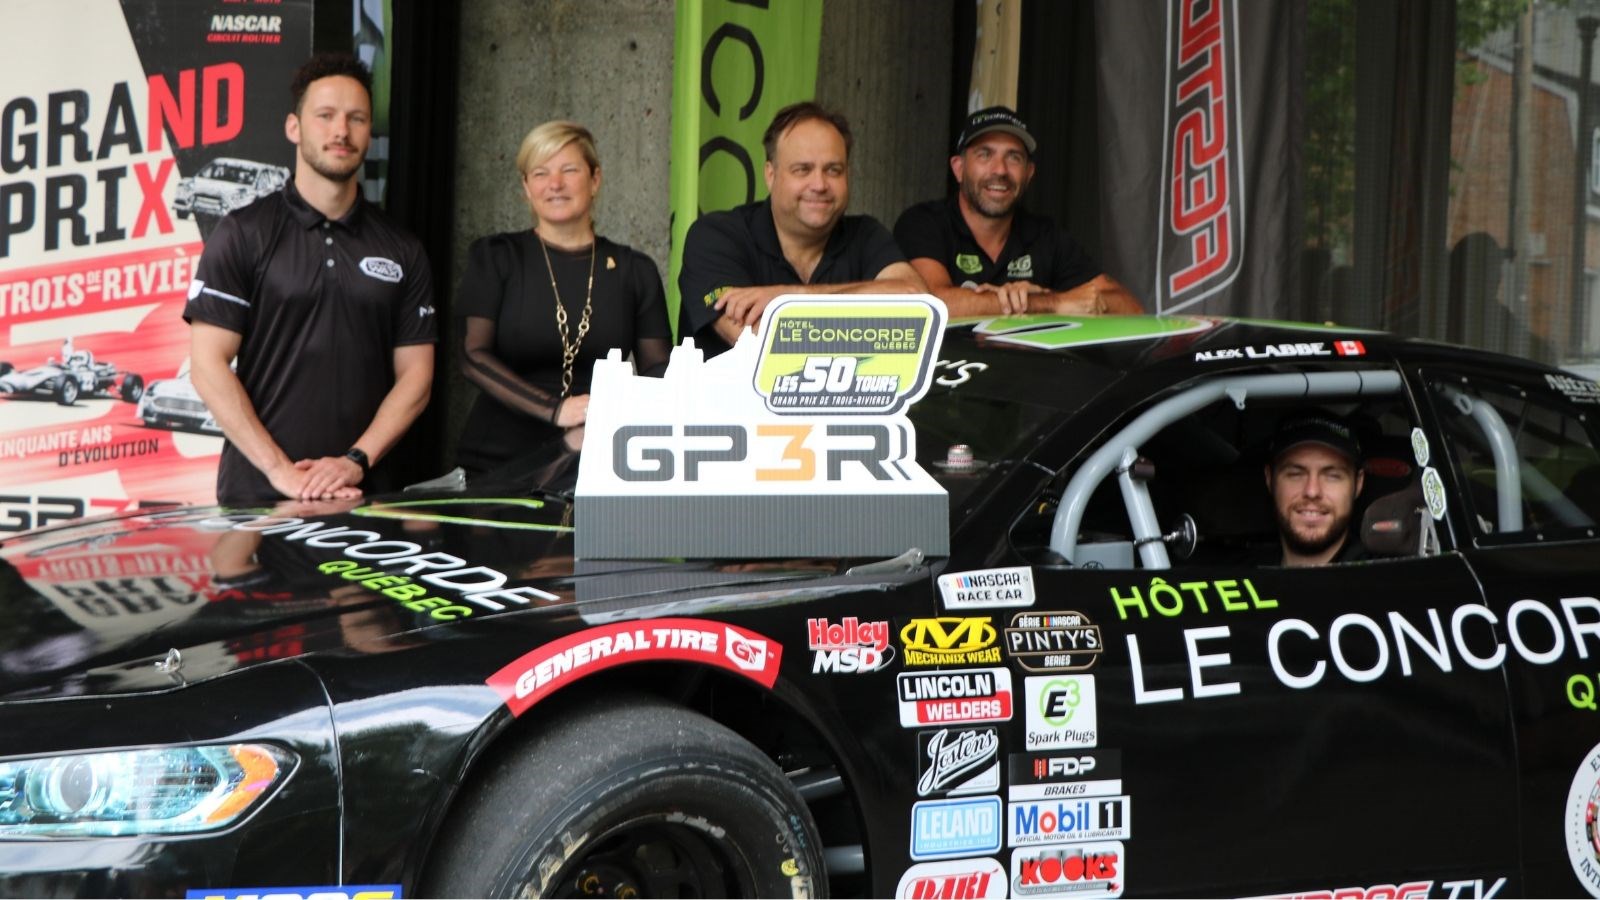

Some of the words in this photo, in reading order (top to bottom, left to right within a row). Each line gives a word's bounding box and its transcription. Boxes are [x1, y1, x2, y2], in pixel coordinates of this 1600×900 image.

[211, 15, 282, 32] NASCAR
[1, 62, 245, 175] GRAND
[0, 157, 176, 258] PRIX
[0, 271, 85, 318] TROIS
[87, 269, 102, 290] DE
[779, 319, 815, 329] HÔTEL
[779, 329, 803, 342] LE
[808, 328, 916, 342] CONCORDE
[1196, 349, 1243, 361] ALEX
[773, 376, 800, 393] LES
[798, 356, 858, 393] 50
[854, 375, 900, 393] TOURS
[772, 395, 798, 406] GRAND
[800, 395, 817, 406] PRIX
[819, 395, 830, 406] DE
[80, 425, 113, 446] ANS
[59, 437, 159, 468] D'ÉVOLUTION
[611, 424, 902, 482] GP3R
[968, 572, 1021, 588] NASCAR
[957, 590, 992, 601] RACE
[996, 588, 1023, 600] CAR
[1110, 577, 1279, 620] HÔTEL
[1018, 615, 1040, 627] SÉRIE
[1052, 615, 1081, 626] NASCAR
[808, 616, 889, 652] Holley
[1011, 629, 1098, 651] PINTY'S
[514, 629, 651, 700] GENERAL
[652, 627, 719, 654] TIRE
[812, 649, 884, 674] MSD
[904, 650, 966, 666] MECHANIX
[967, 649, 1002, 664] WEAR
[1044, 655, 1071, 667] SERIES
[1126, 625, 1241, 705] LE
[903, 674, 992, 700] LINCOLN
[925, 699, 1001, 720] WELDERS
[1028, 730, 1060, 745] Spark
[1064, 729, 1095, 744] Plugs
[918, 728, 999, 796] Jostens
[1048, 756, 1096, 776] FDP
[1043, 784, 1087, 796] BRAKES
[920, 807, 993, 839] LELAND
[1015, 801, 1090, 835] Mobil
[1020, 852, 1118, 885] KOOKS
